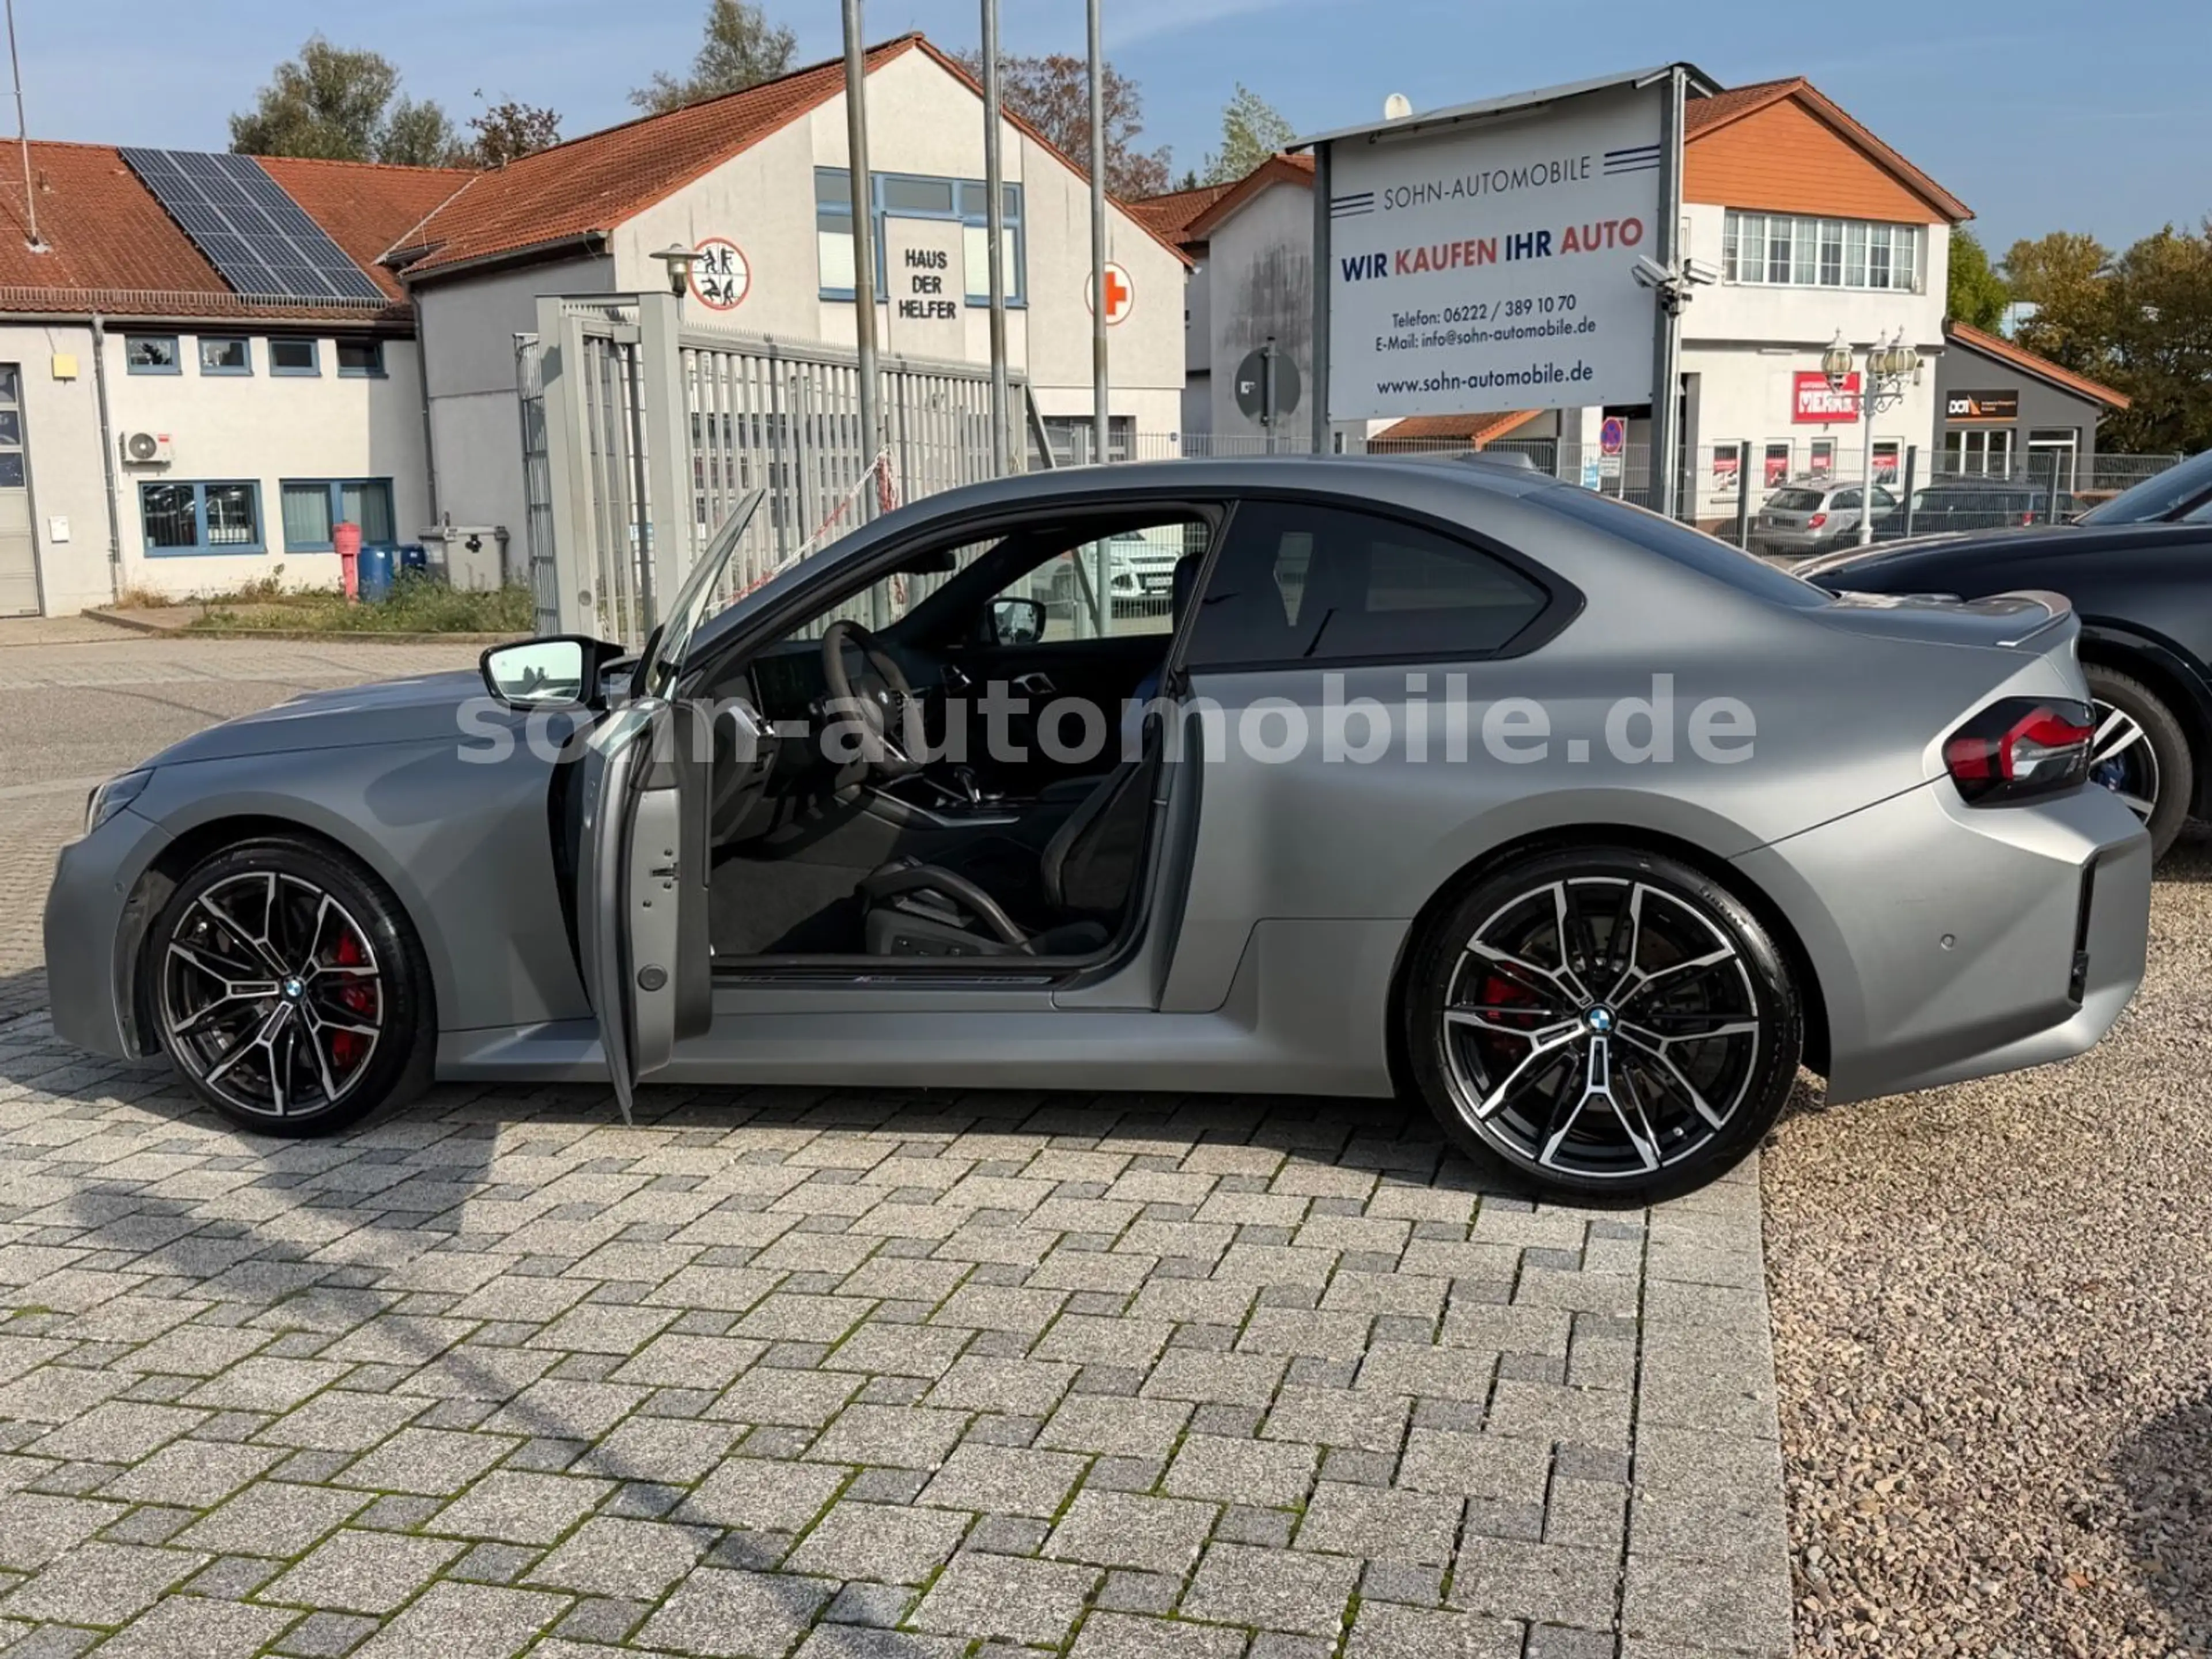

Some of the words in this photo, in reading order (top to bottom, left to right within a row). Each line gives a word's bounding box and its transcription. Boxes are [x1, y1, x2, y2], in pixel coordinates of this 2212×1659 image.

[1384, 156, 1590, 210] SOHN-AUTOMOBILE
[906, 248, 948, 269] HAUS
[1342, 253, 1388, 283] WIR
[1395, 237, 1497, 275] KAUFEN
[1506, 230, 1552, 262] IHR
[1559, 217, 1643, 255] AUTO
[912, 275, 941, 294] DER
[899, 299, 956, 319] HELFER
[1392, 309, 1441, 328] Telefon:
[1444, 303, 1487, 323] 06222
[1490, 301, 1501, 322] /
[1505, 298, 1532, 317] 389
[1537, 297, 1554, 313] 10
[1558, 294, 1576, 311] 70
[1376, 333, 1419, 351] E-Mail:
[1421, 315, 1596, 347] info@sohn-automobile.de
[1377, 359, 1593, 394] www.sohn-automobile.de
